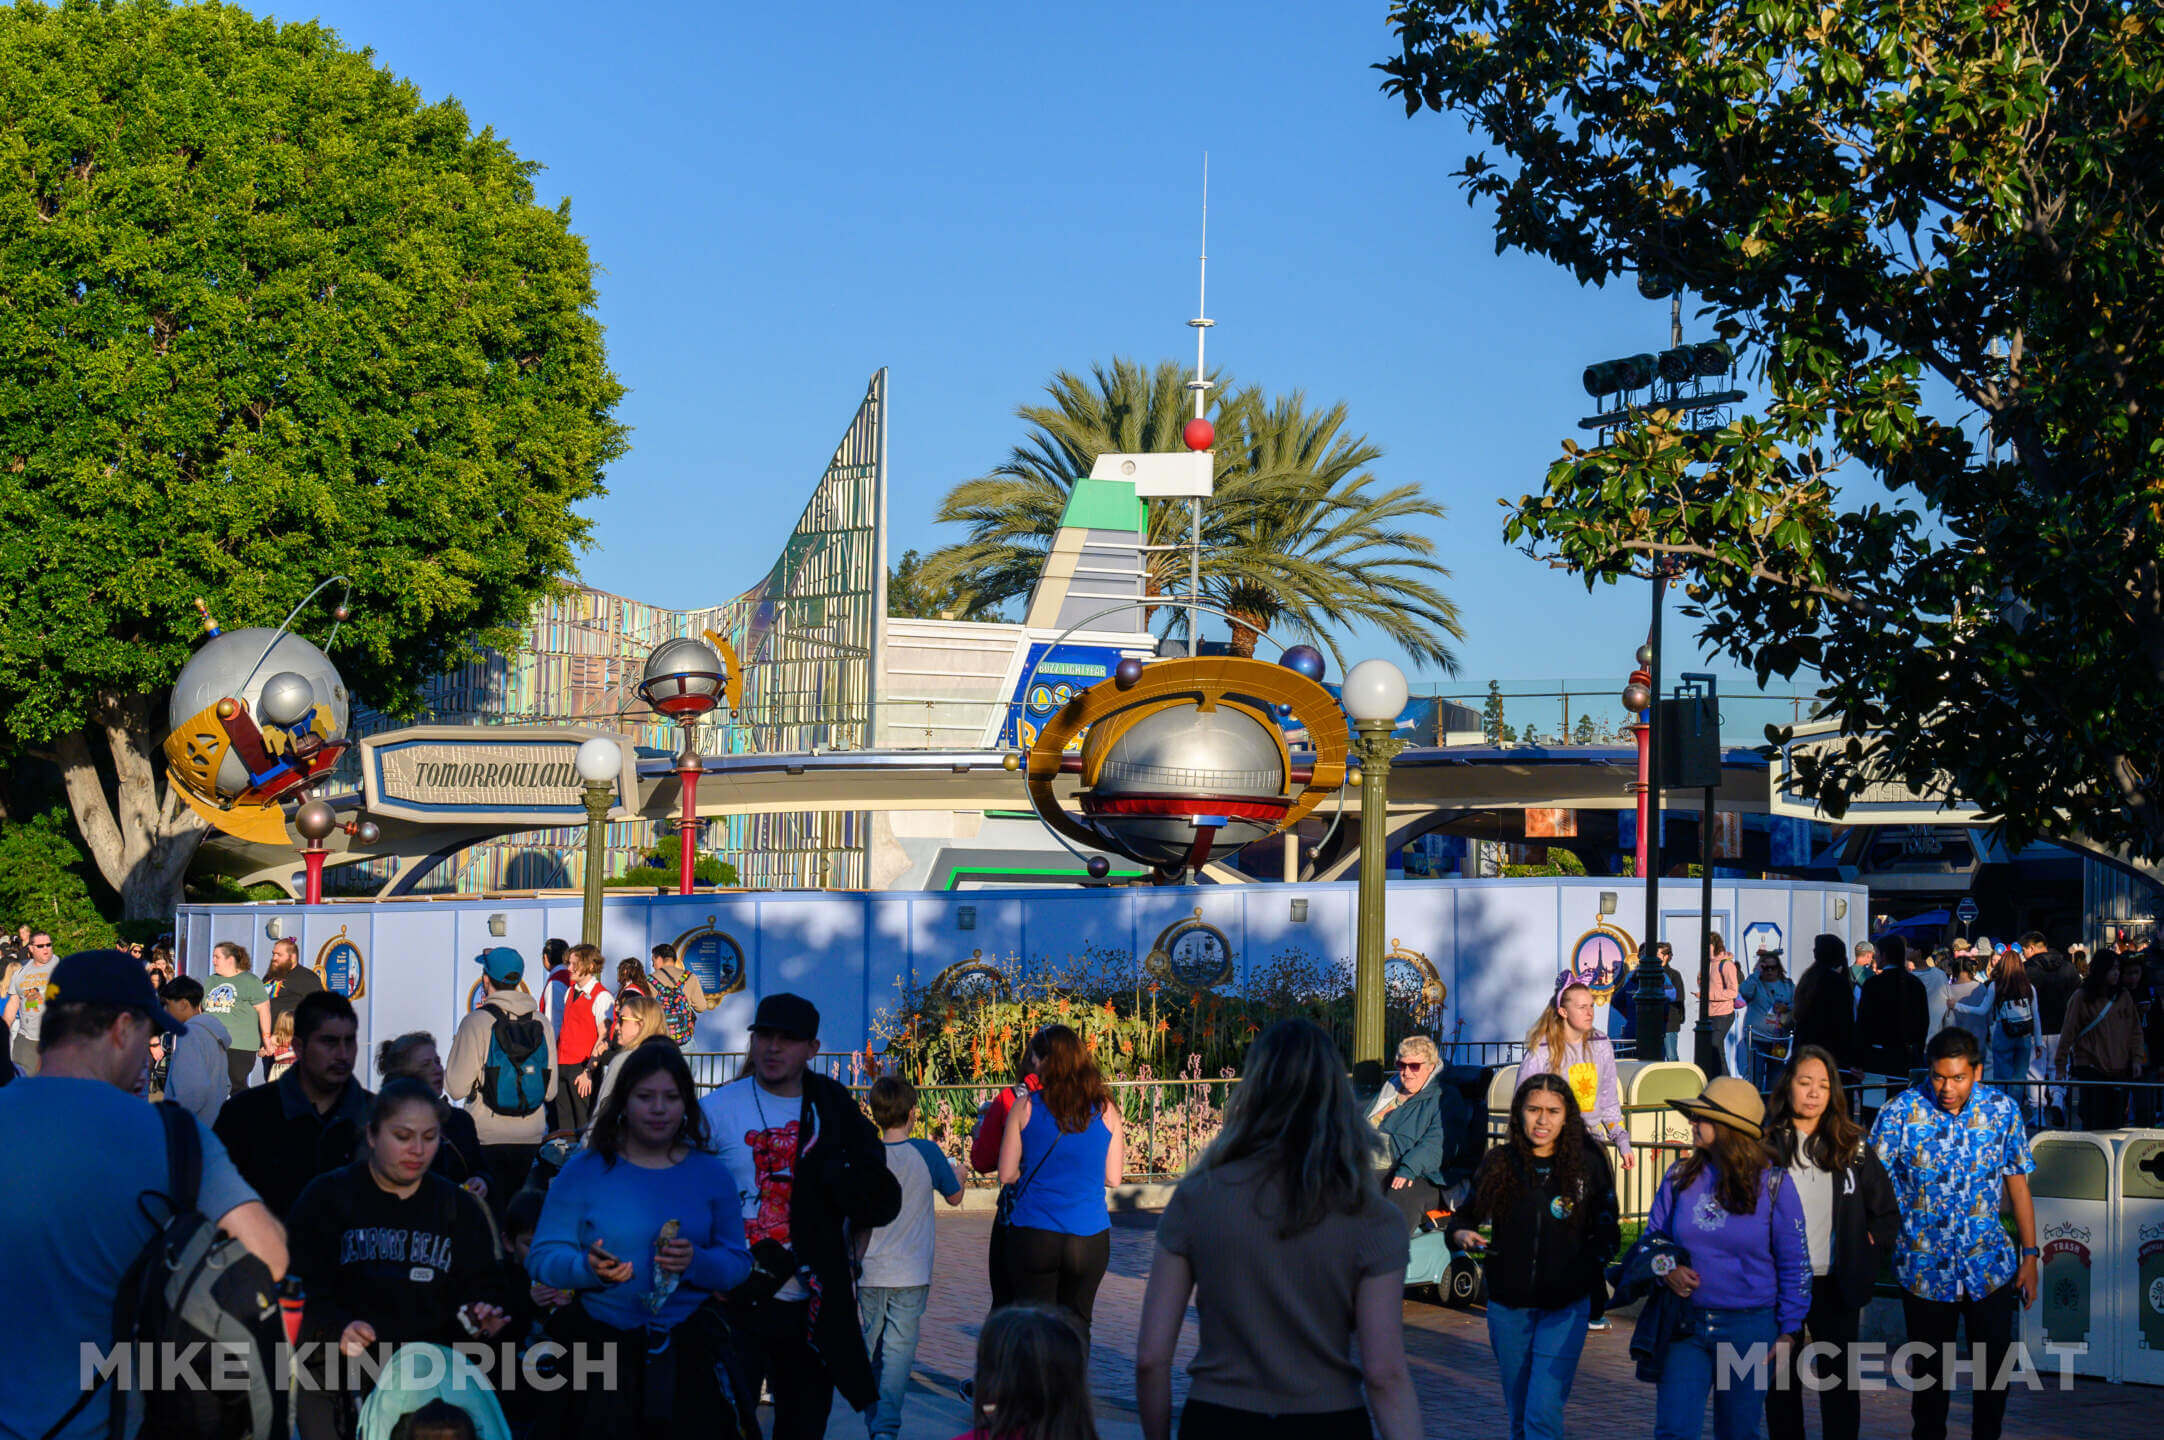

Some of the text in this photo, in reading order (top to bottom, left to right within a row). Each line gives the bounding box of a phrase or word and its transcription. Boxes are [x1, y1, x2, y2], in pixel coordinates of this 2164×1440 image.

[1039, 663, 1106, 677] BUZZ LIGHTYEAR
[2054, 1241, 2081, 1255] TRASH
